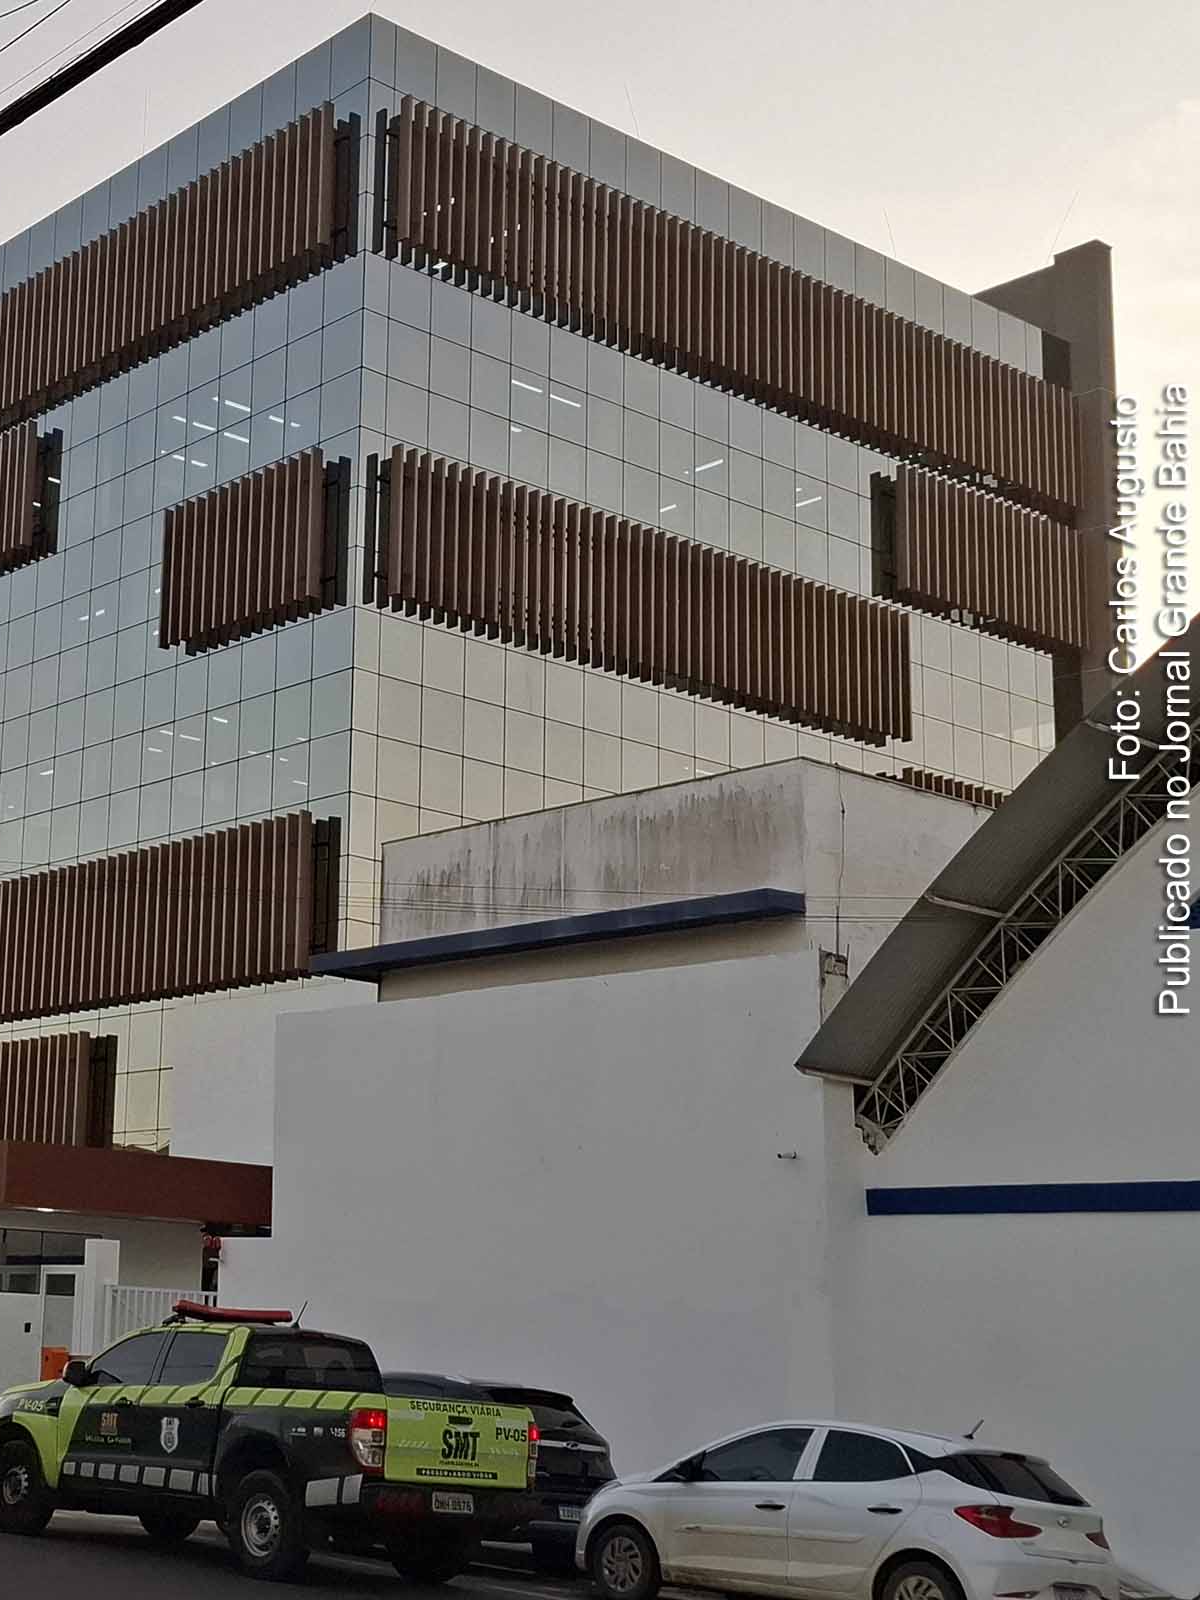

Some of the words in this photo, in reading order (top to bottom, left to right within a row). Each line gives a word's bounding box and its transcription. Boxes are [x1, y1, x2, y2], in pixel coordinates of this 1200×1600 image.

[409, 1400, 467, 1416] SEGURANÇA
[495, 1427, 528, 1442] PV-05
[441, 1429, 481, 1461] SMT
